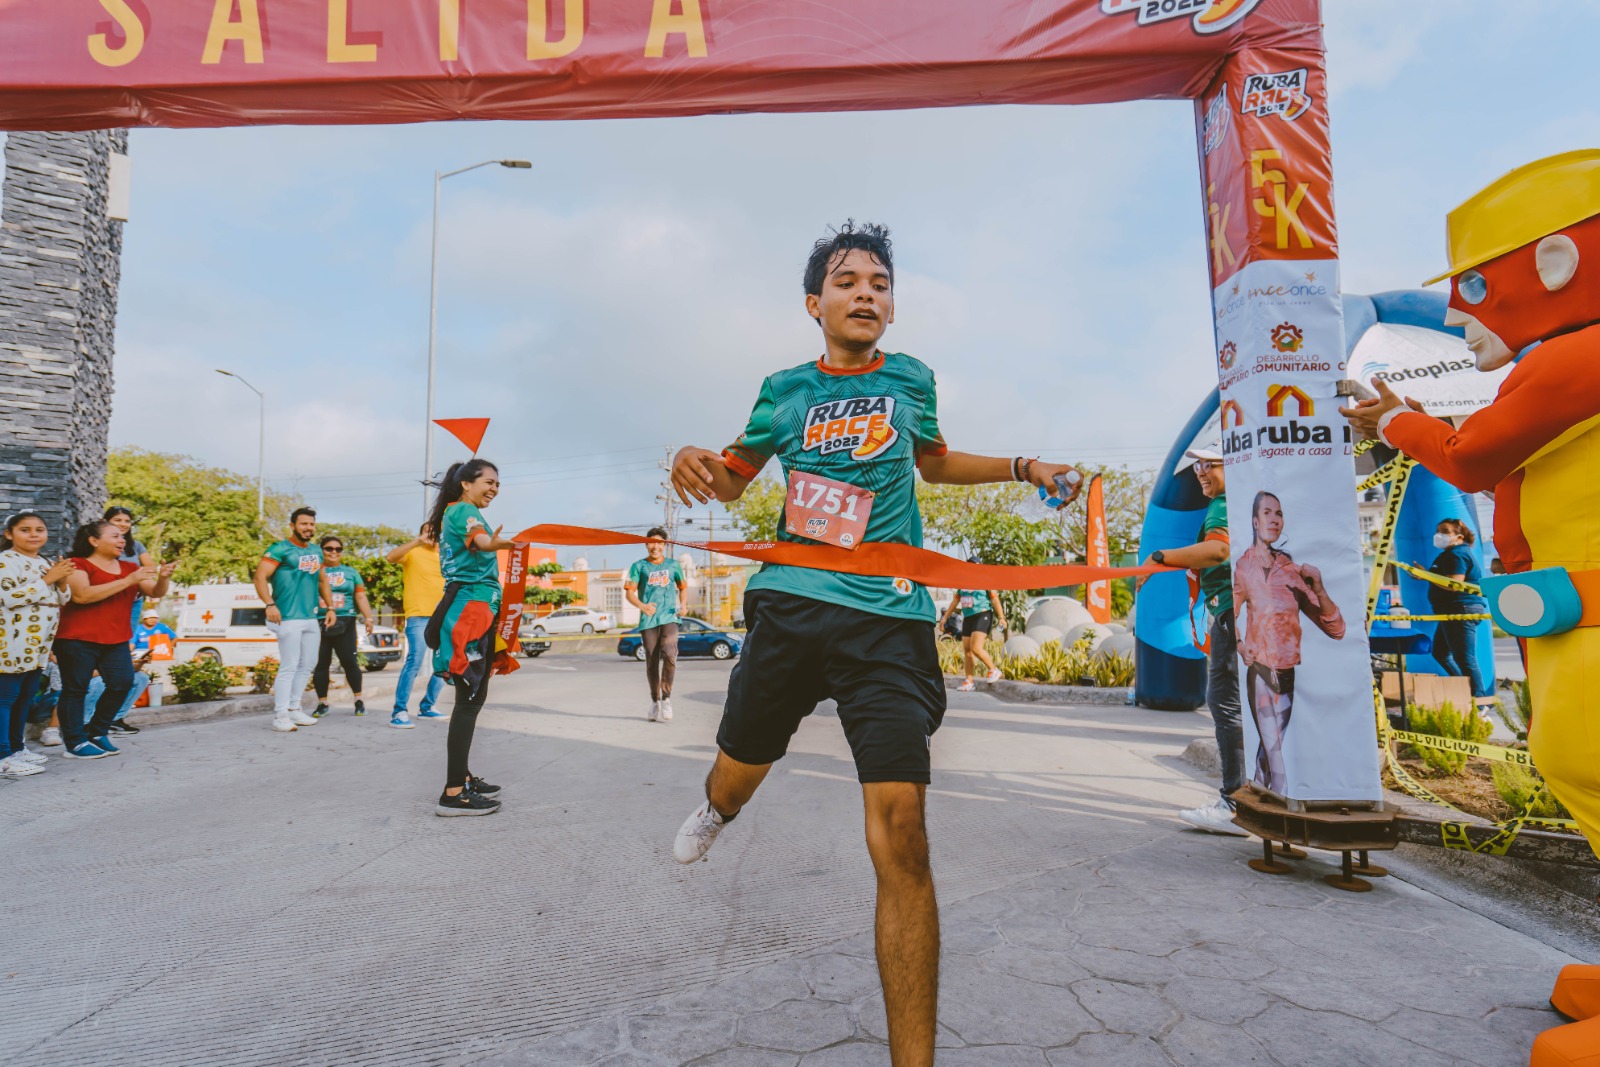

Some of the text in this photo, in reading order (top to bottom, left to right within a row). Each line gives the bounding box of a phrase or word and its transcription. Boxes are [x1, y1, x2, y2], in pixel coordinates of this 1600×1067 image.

[87, 0, 708, 67] SALIDA
[1248, 72, 1300, 94] RUBA
[1251, 149, 1314, 249] 5K
[1251, 362, 1331, 375] COMUNITARIO
[1257, 355, 1319, 364] DESARROLLO
[1375, 359, 1475, 383] Rotoplas
[809, 397, 888, 426] RUBA
[805, 414, 888, 447] RACE
[824, 436, 860, 451] 2022
[1257, 420, 1332, 445] ruba
[792, 480, 858, 521] 1751
[511, 550, 523, 584] ruba
